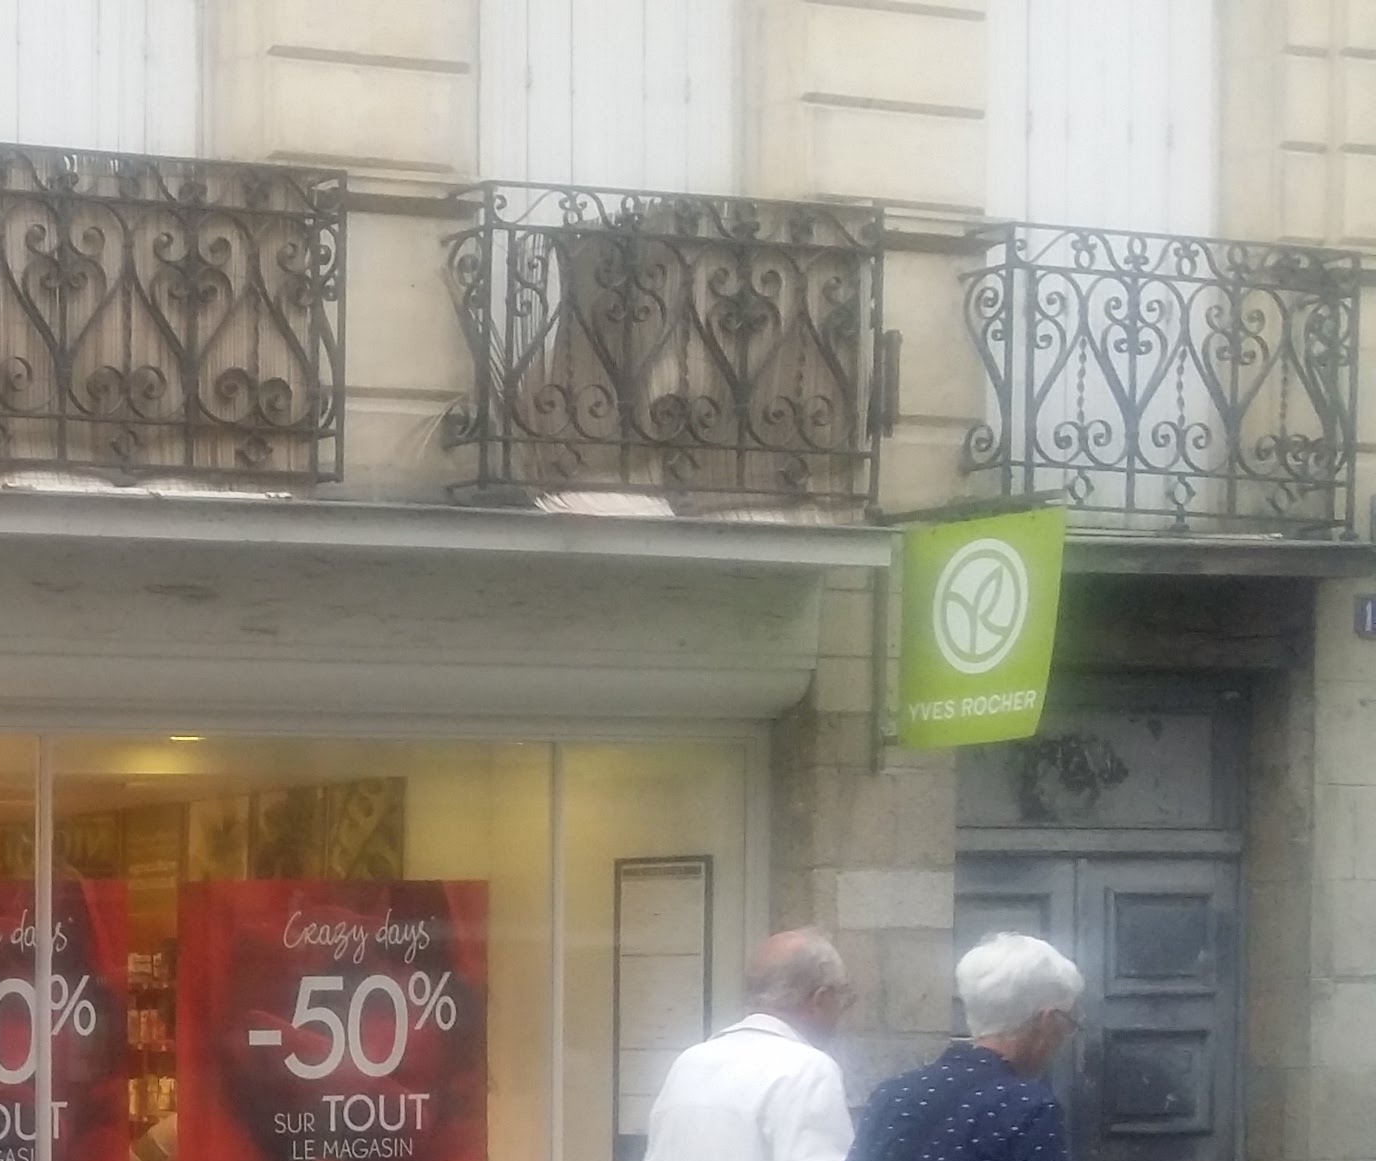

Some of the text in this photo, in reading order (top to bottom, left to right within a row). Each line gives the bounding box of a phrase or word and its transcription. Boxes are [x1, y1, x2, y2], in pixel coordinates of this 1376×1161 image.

[908, 690, 1036, 721] YVES ROCHER
[10, 909, 68, 953] das
[284, 911, 368, 964] Crazy
[249, 971, 457, 1079] -50%
[274, 1094, 430, 1134] SUR TOUT
[293, 1137, 413, 1160] LE MAGASIN
